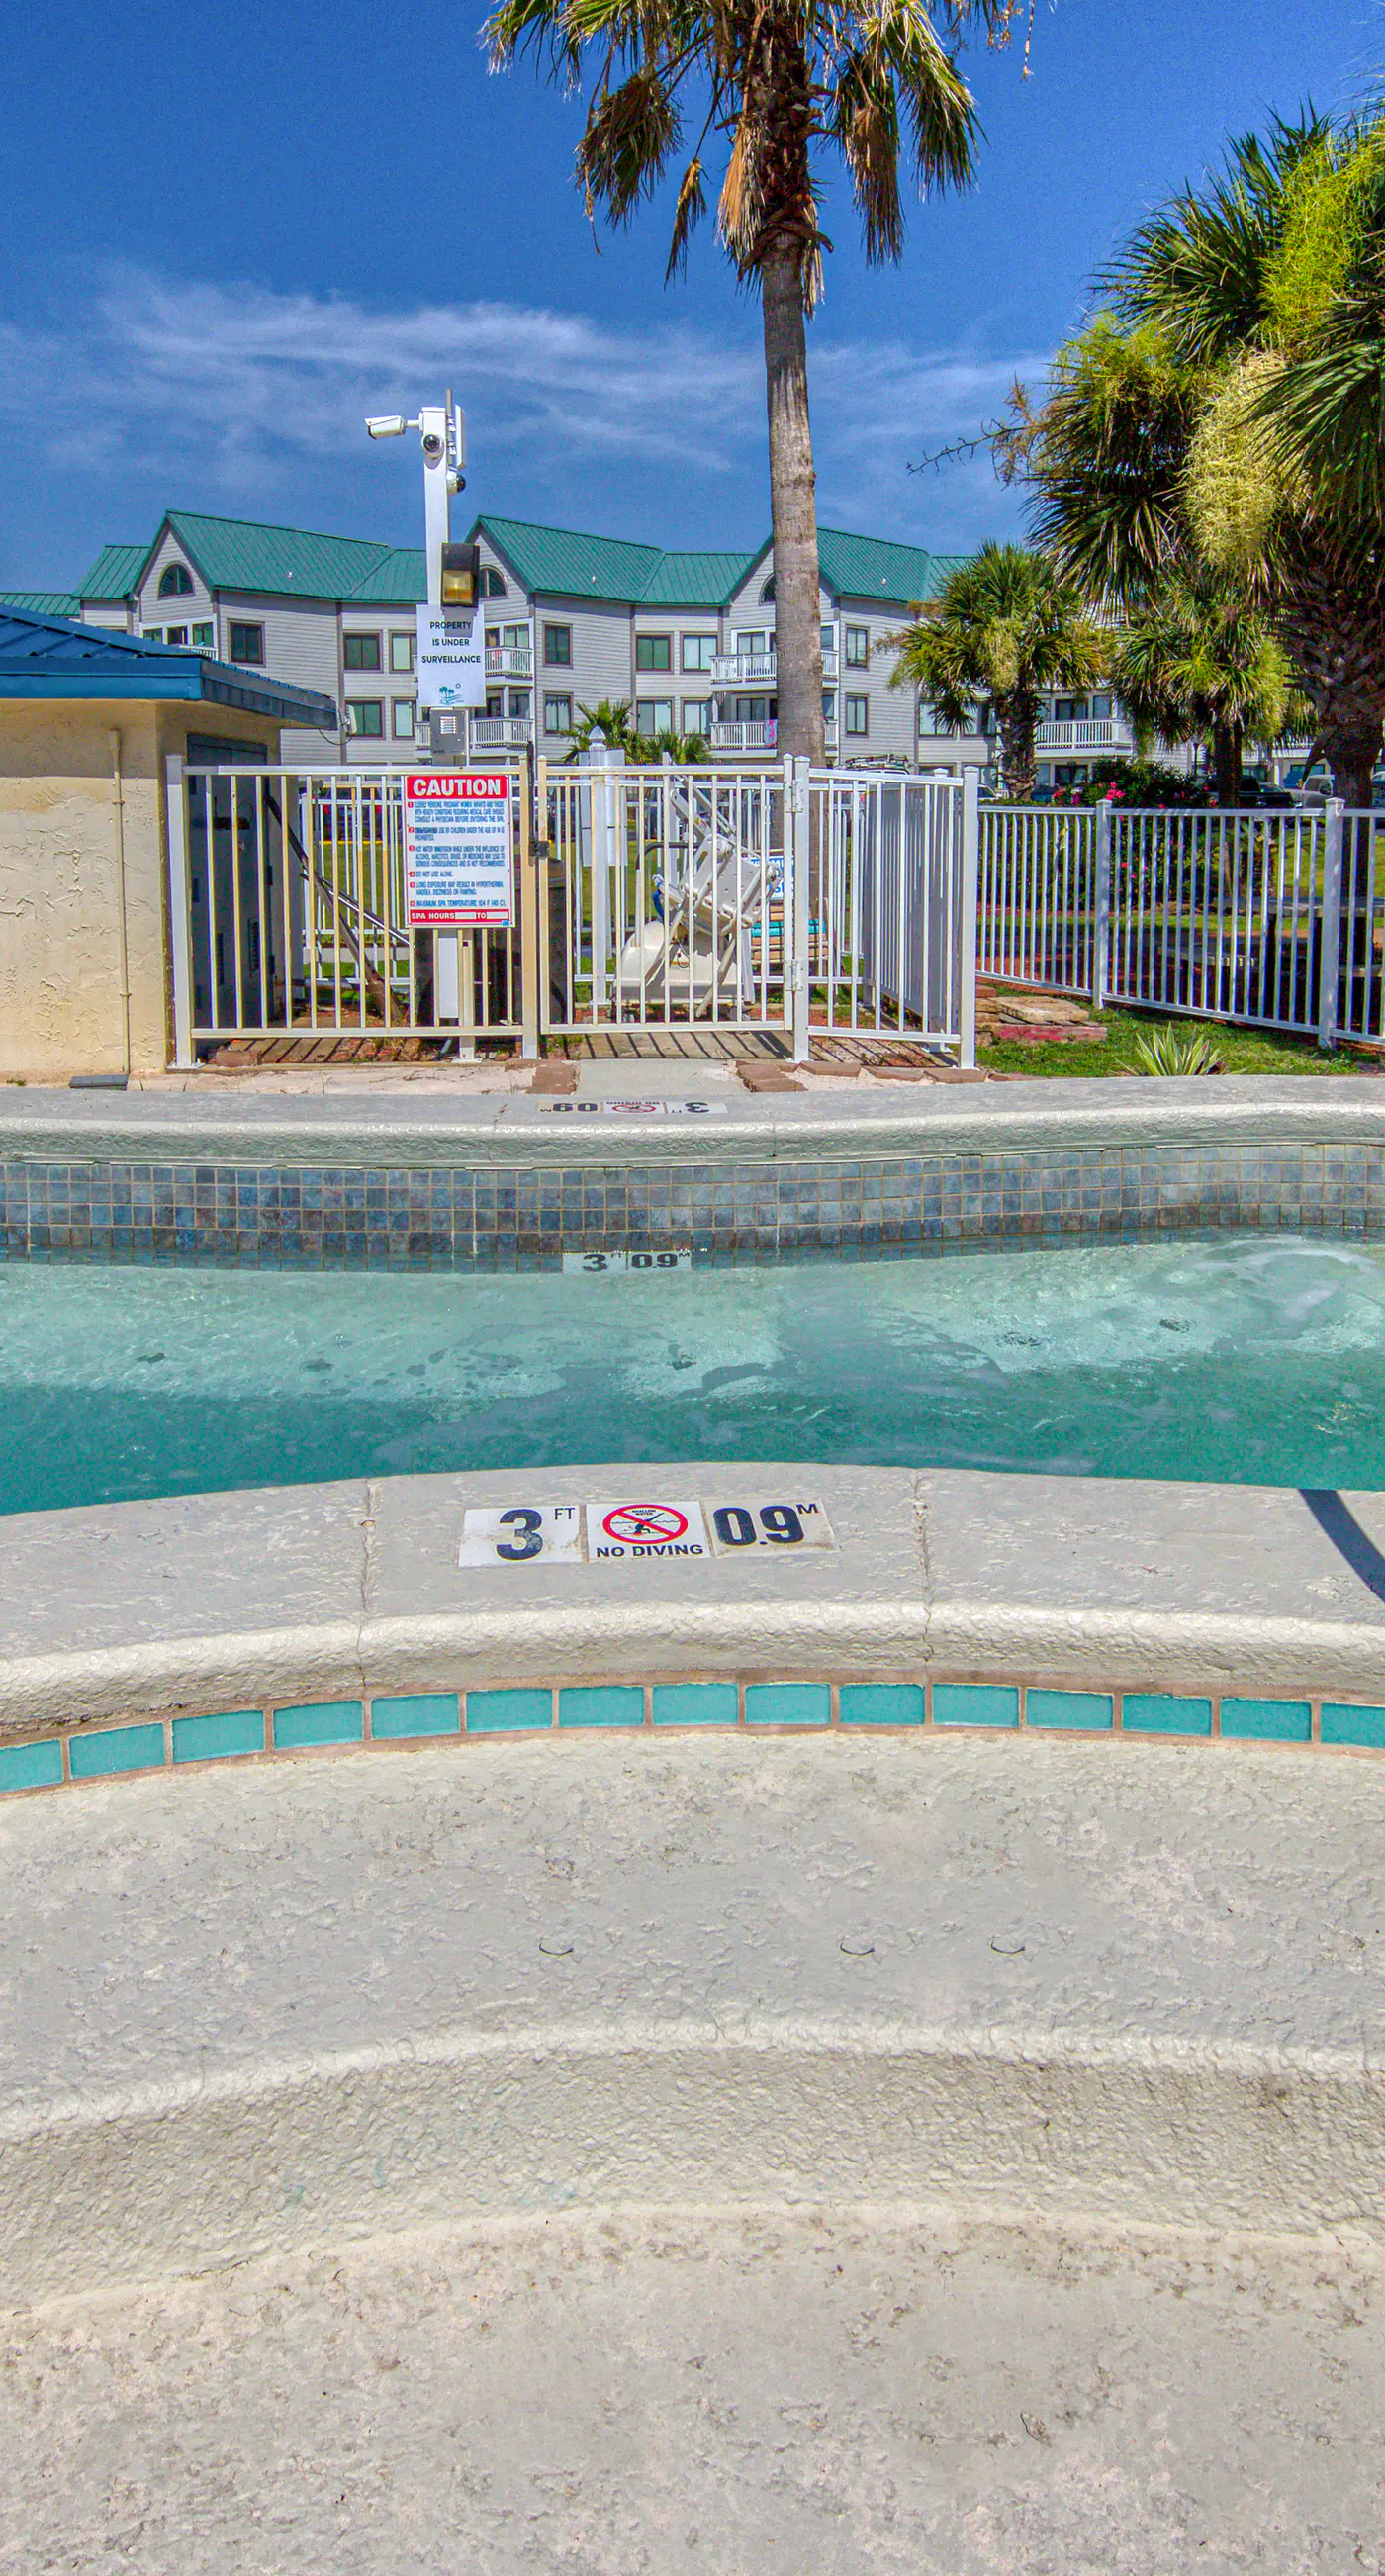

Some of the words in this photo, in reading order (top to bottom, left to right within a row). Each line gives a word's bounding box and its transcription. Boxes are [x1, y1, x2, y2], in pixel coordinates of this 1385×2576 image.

[413, 779, 500, 796] CAUTION
[685, 1102, 710, 1113] 3
[583, 1254, 608, 1272] 3
[631, 1254, 677, 1269] 0.9
[713, 1505, 804, 1546] 0.9
[796, 1503, 819, 1515] M
[496, 1508, 543, 1560] 3
[554, 1507, 575, 1520] FT
[597, 1546, 625, 1557] NO
[633, 1544, 703, 1557] DIVING
